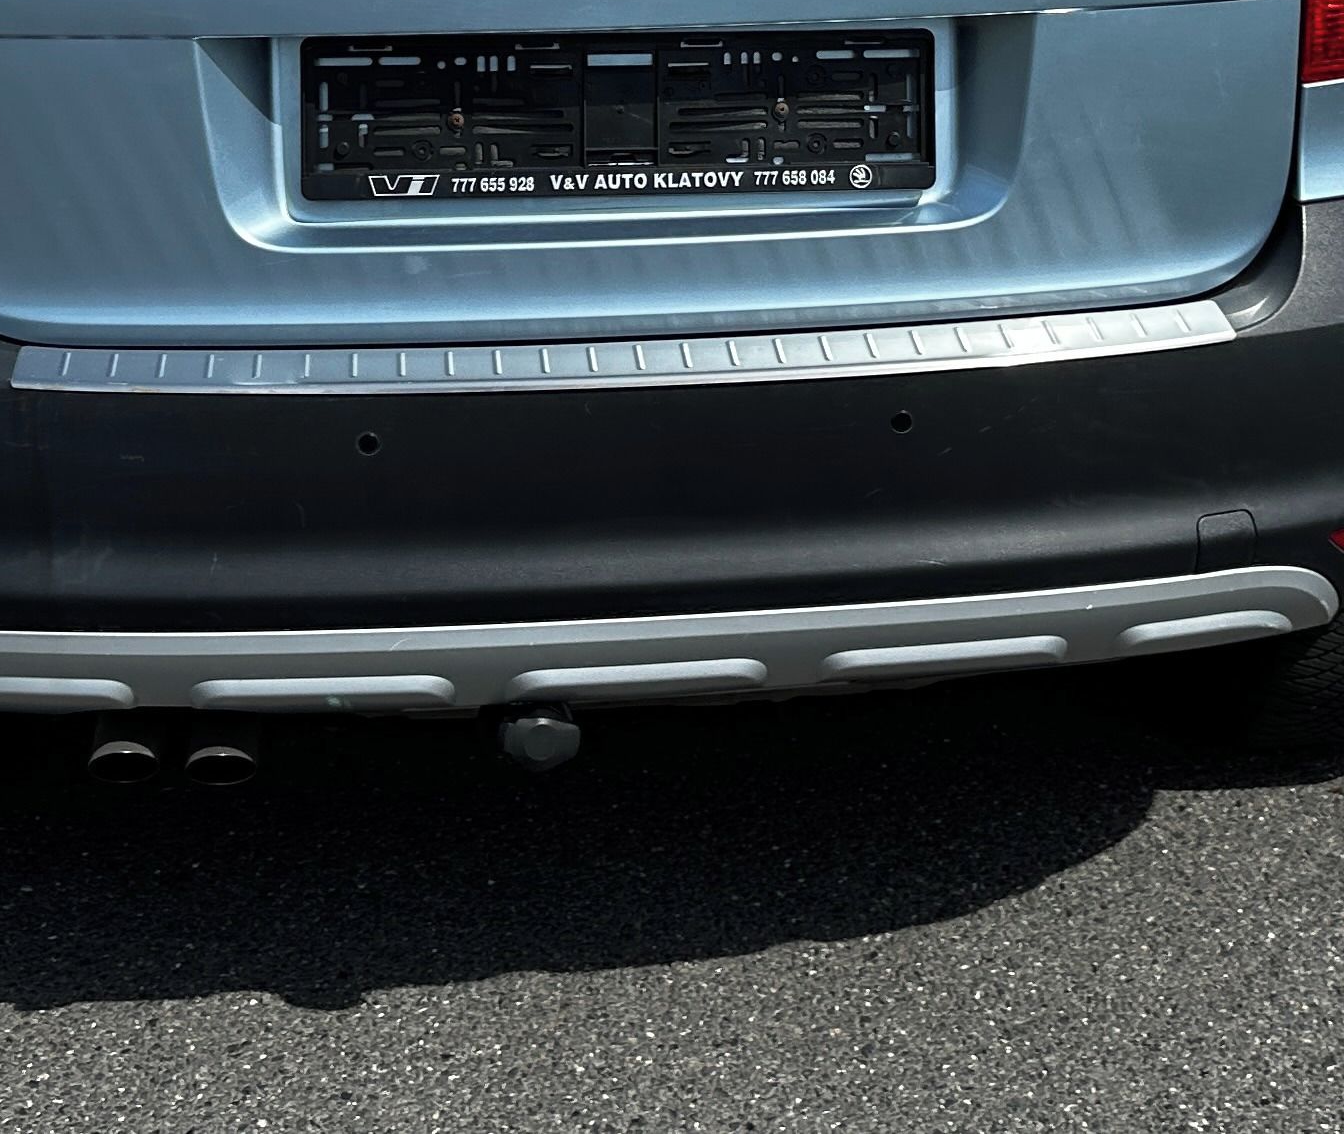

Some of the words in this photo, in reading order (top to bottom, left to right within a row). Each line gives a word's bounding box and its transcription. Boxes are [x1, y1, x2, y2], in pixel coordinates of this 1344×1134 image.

[451, 177, 477, 192] 777
[480, 177, 506, 193] 655
[509, 176, 535, 192] 928
[549, 174, 590, 190] V&V
[594, 173, 648, 190] AUTO
[653, 171, 744, 189] KLATOVY
[754, 171, 779, 186] 777
[782, 170, 807, 186] 658
[810, 169, 836, 185] 084
